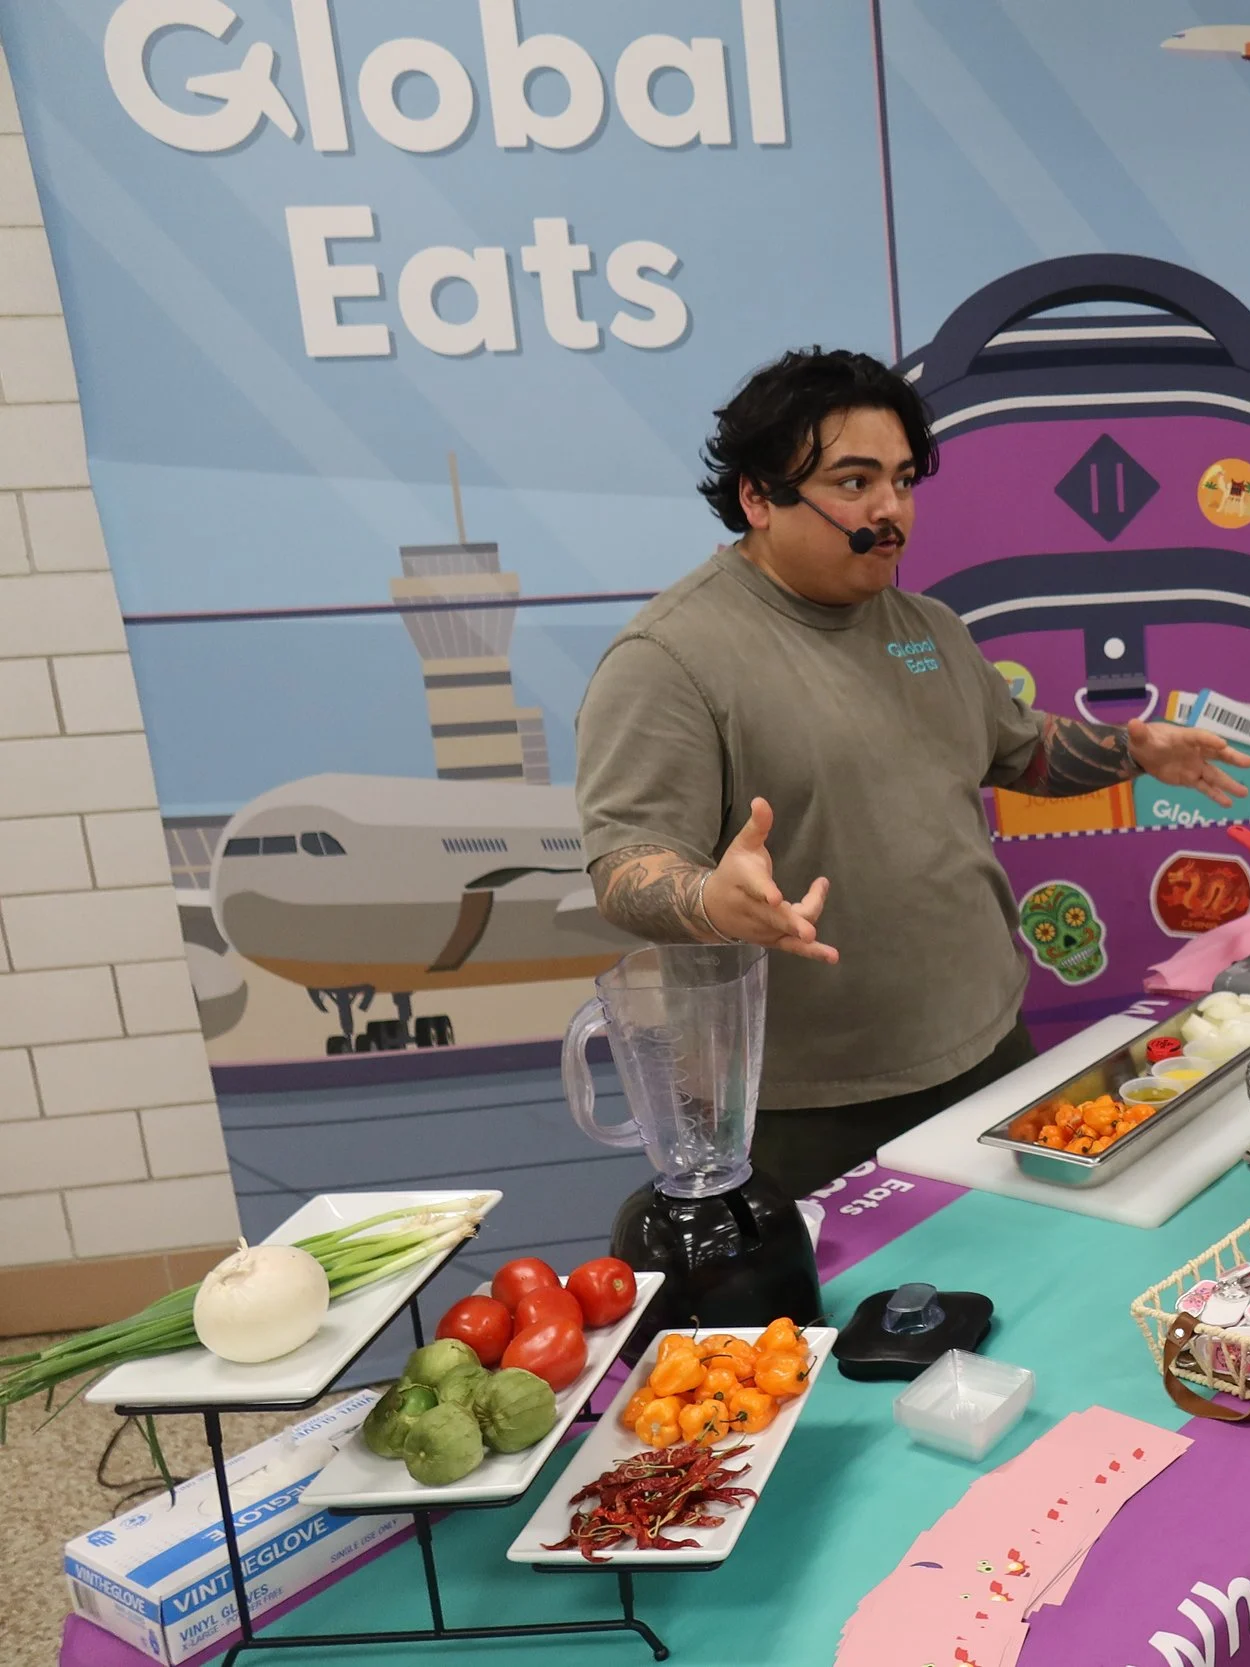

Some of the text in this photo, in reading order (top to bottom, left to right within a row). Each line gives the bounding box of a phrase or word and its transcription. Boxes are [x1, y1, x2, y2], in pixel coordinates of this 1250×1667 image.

[104, 0, 792, 154] Global
[285, 205, 692, 358] Eats
[1152, 799, 1229, 827] Glob
[839, 1178, 916, 1216] Eats
[74, 1563, 147, 1615] VINTHEGLOVE
[172, 1515, 330, 1614] VINTEGLOVE
[179, 1614, 219, 1643] VINYL
[221, 1583, 270, 1619] GLVES
